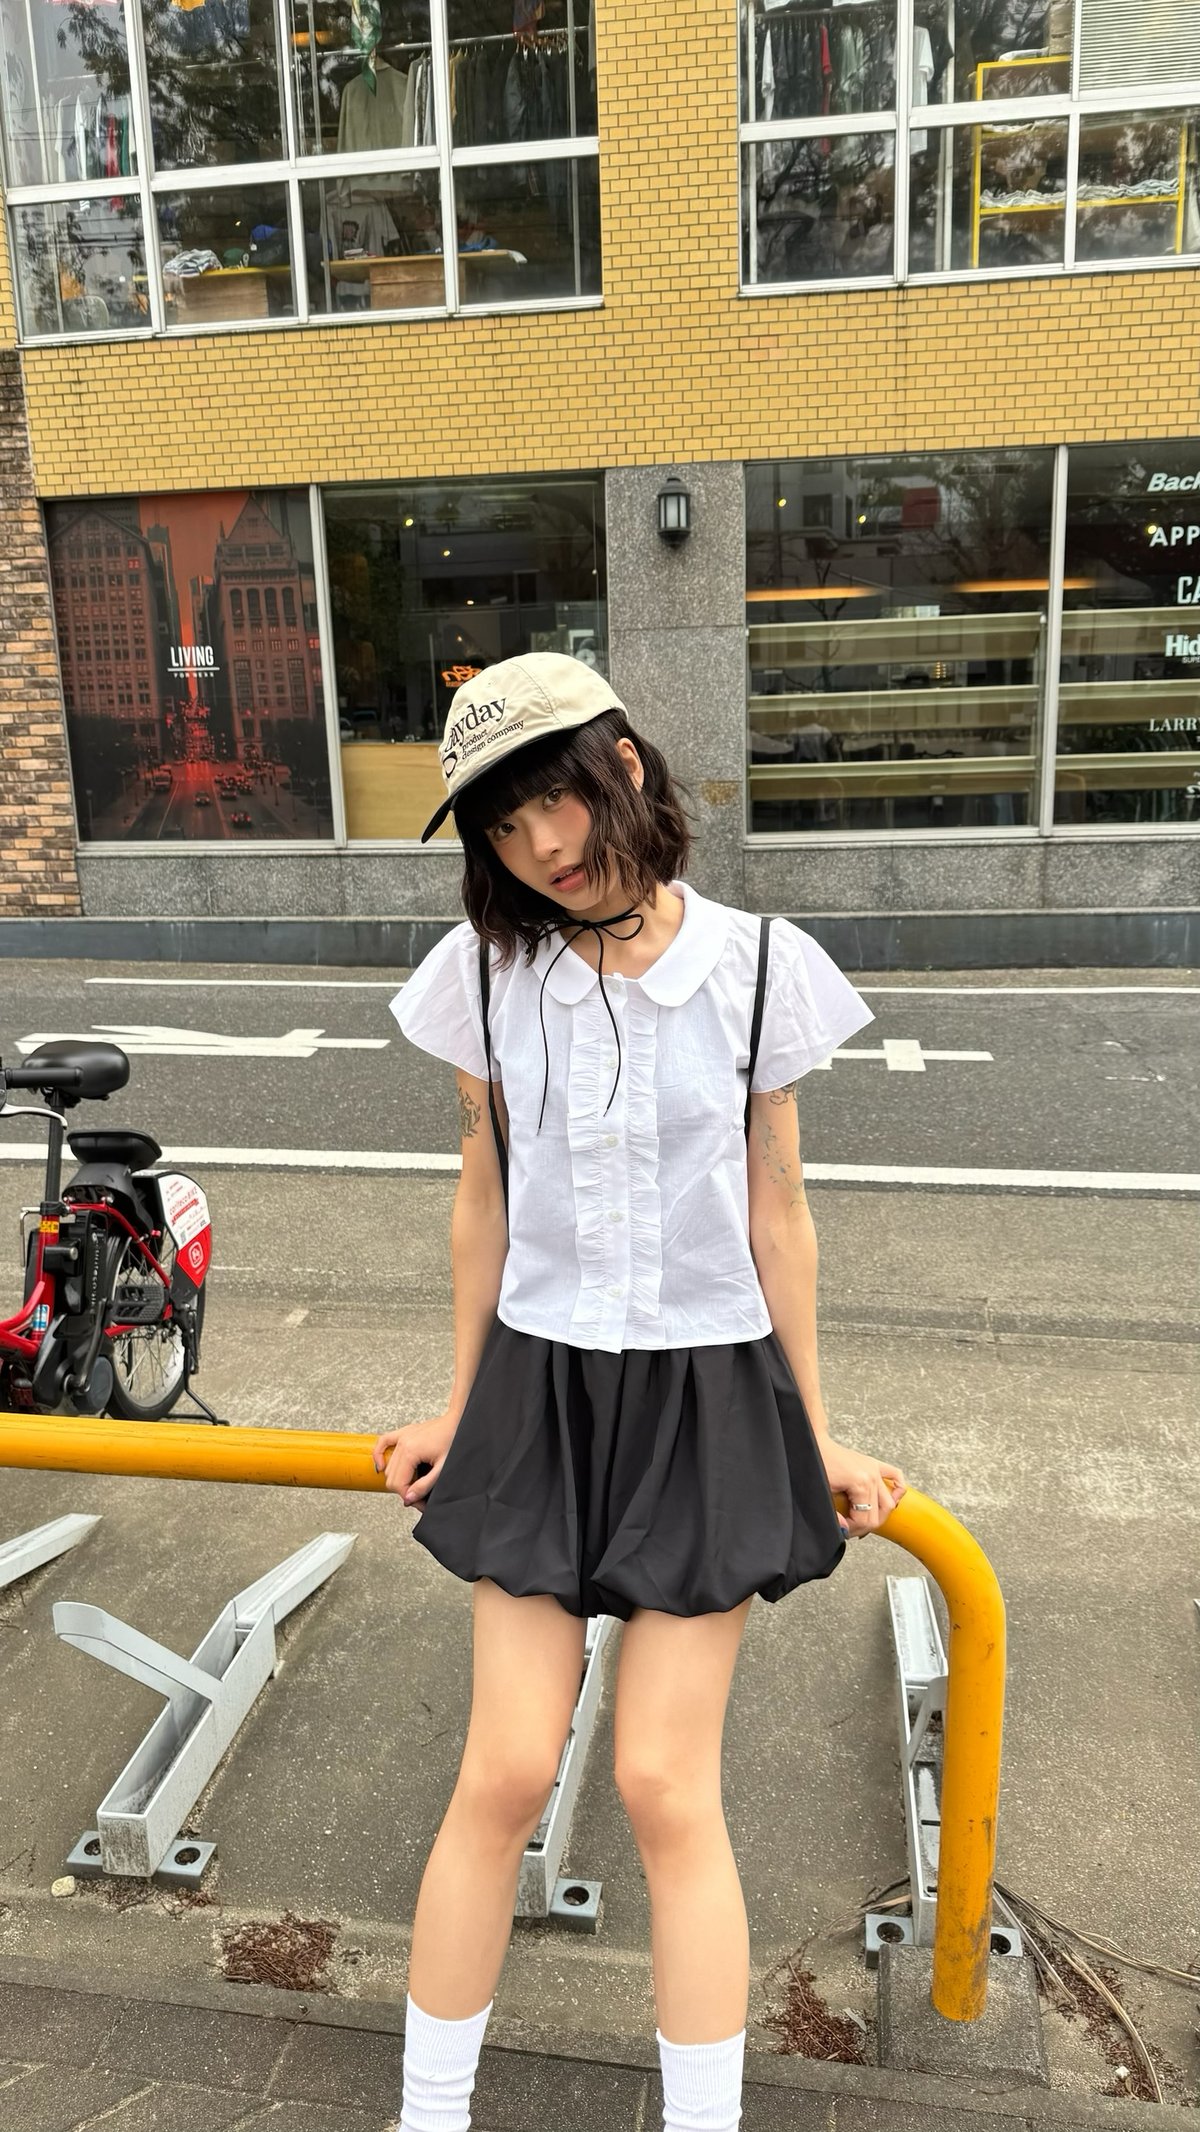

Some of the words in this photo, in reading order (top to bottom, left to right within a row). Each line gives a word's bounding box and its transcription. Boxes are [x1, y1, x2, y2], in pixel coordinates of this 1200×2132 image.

[170, 645, 214, 667] LIVING
[1149, 717, 1200, 732] LARR
[461, 741, 486, 760] design
[487, 720, 524, 744] company
[461, 729, 488, 753] product
